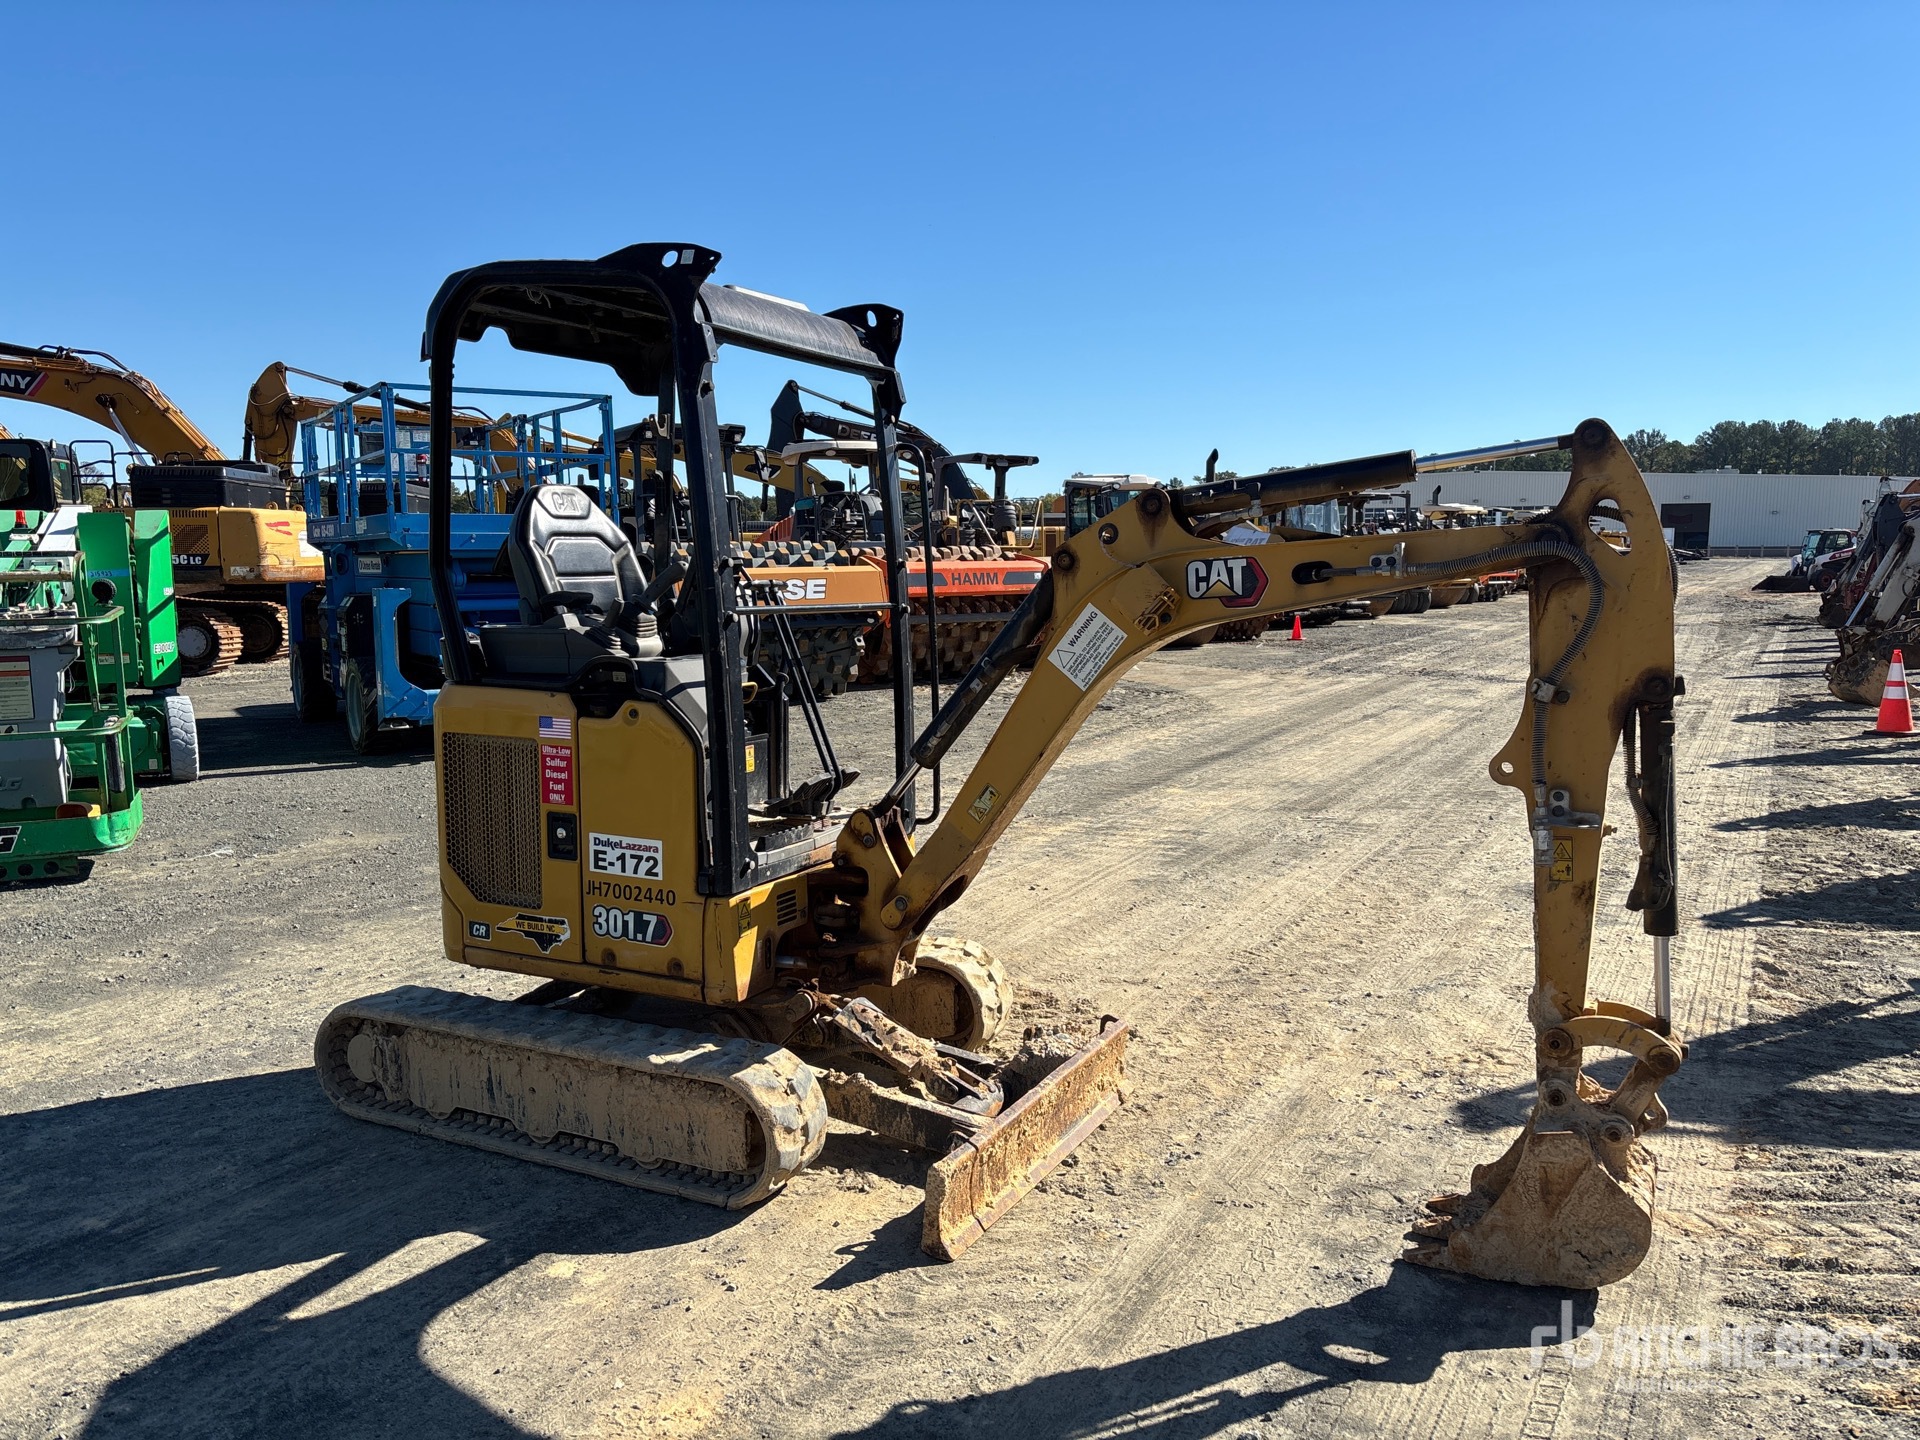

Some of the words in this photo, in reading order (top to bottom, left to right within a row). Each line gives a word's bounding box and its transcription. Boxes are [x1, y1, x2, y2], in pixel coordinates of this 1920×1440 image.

[190, 556, 202, 564] LC
[951, 571, 999, 586] HAMM
[1187, 559, 1247, 598] CAT
[1068, 611, 1098, 647] WARNING
[542, 745, 571, 755] Ultra-Low
[546, 757, 567, 768] Sulfur
[545, 769, 568, 780] Diesel
[549, 781, 565, 791] Fuel
[549, 793, 565, 801] ONLY
[593, 836, 659, 853] DukeLazzara
[593, 849, 659, 877] E-172
[586, 880, 676, 906] JH7002440
[515, 920, 526, 929] WE
[527, 922, 545, 932] BUILD
[546, 925, 556, 933] NC
[593, 905, 658, 942] 301.7
[472, 924, 486, 937] CR
